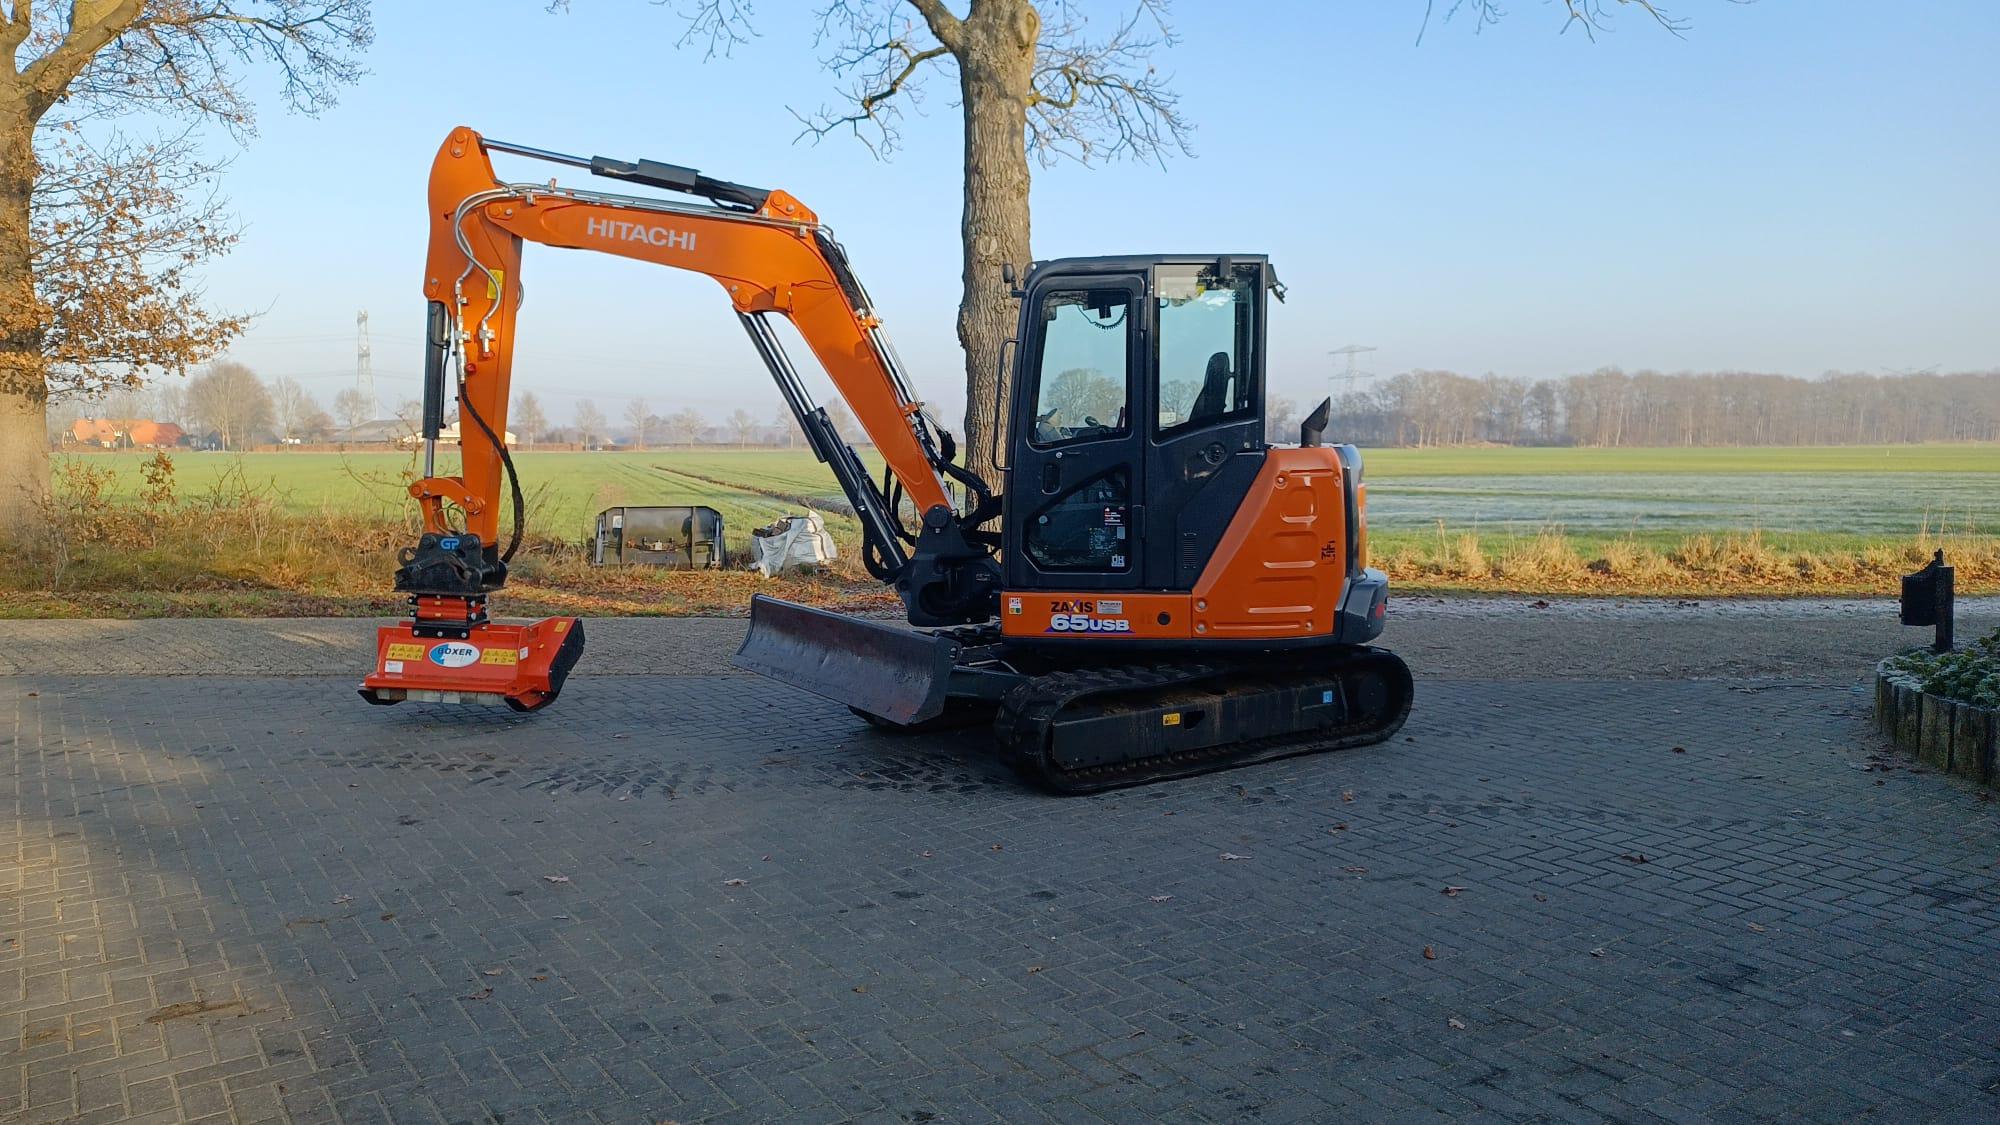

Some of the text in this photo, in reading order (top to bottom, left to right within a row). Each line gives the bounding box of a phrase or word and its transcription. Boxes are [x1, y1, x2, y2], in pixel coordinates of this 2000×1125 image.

[587, 216, 697, 251] HITACHI
[440, 537, 460, 550] GP
[1051, 600, 1093, 613] ZAXIS
[1051, 614, 1130, 631] 65USB
[437, 647, 473, 656] BOXER
